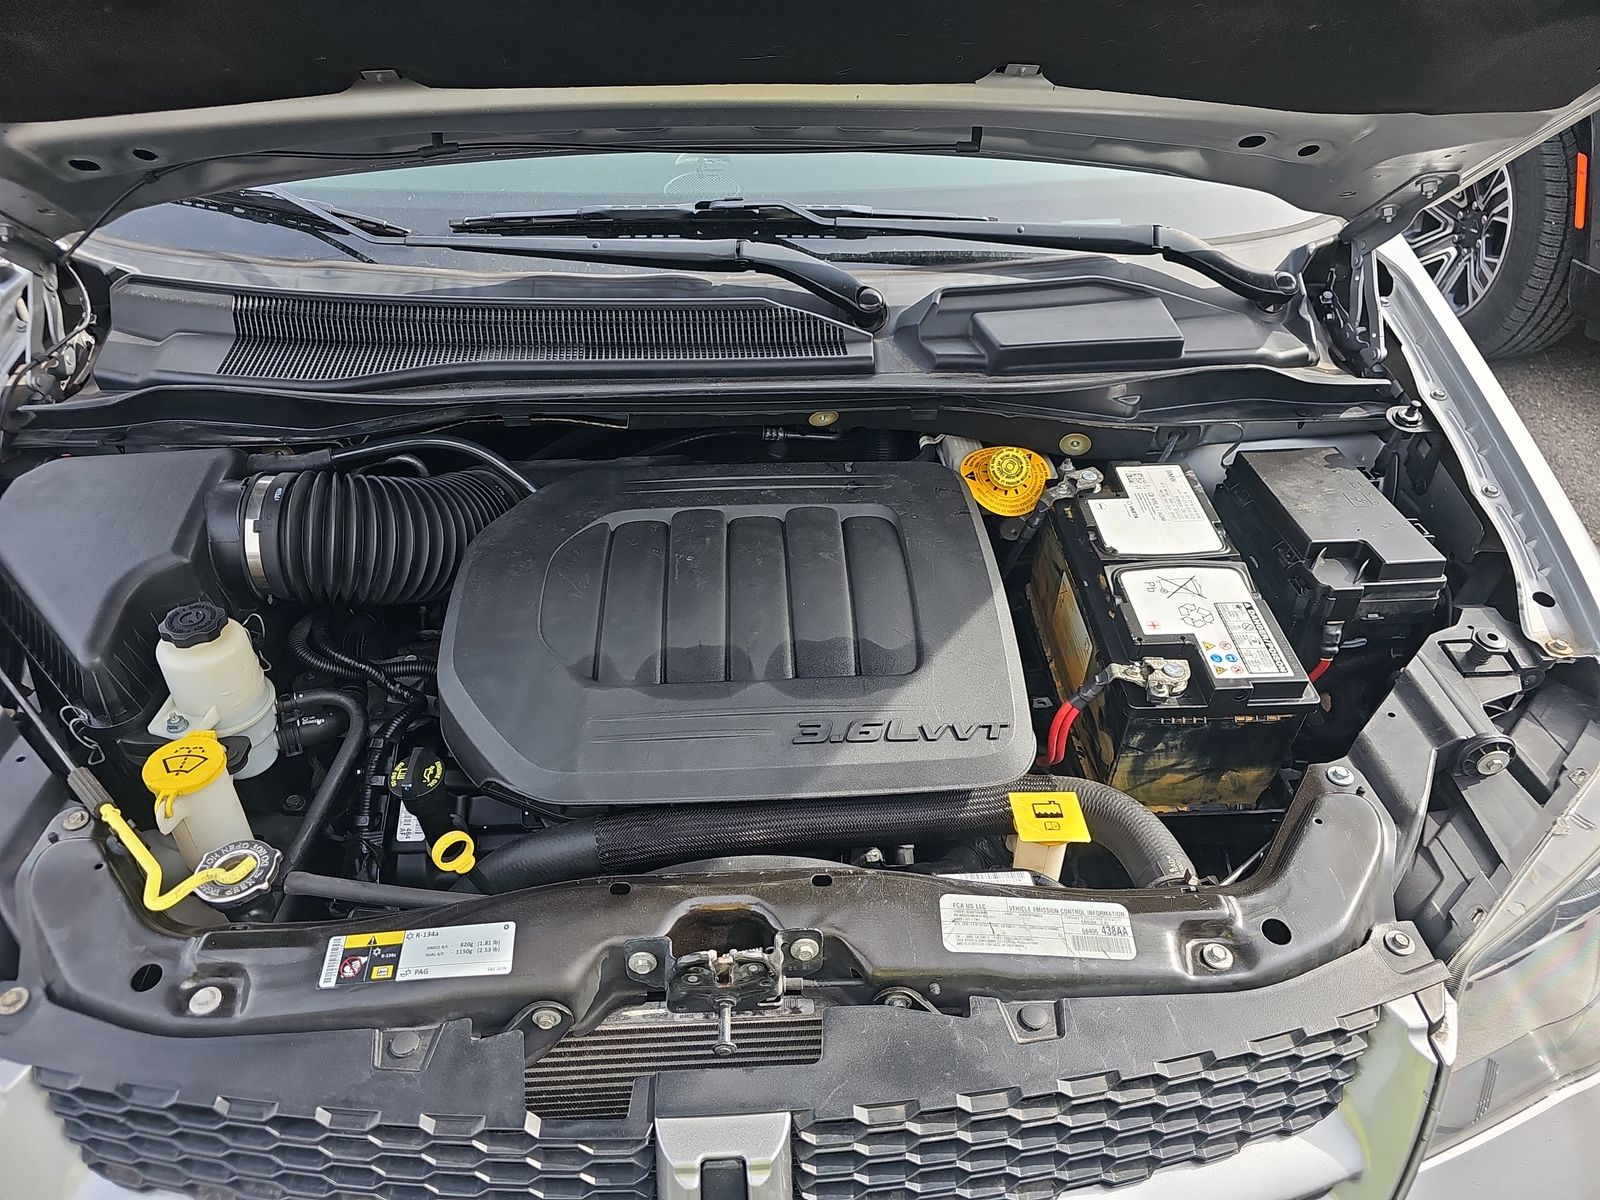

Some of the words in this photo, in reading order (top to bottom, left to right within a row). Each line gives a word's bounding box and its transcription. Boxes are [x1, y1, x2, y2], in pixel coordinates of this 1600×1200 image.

[1248, 610, 1287, 672] DANGER/POISON
[427, 780, 438, 788] OIL
[222, 842, 249, 854] OPEN
[225, 878, 256, 896] KEEP
[1101, 925, 1129, 936] 438AA
